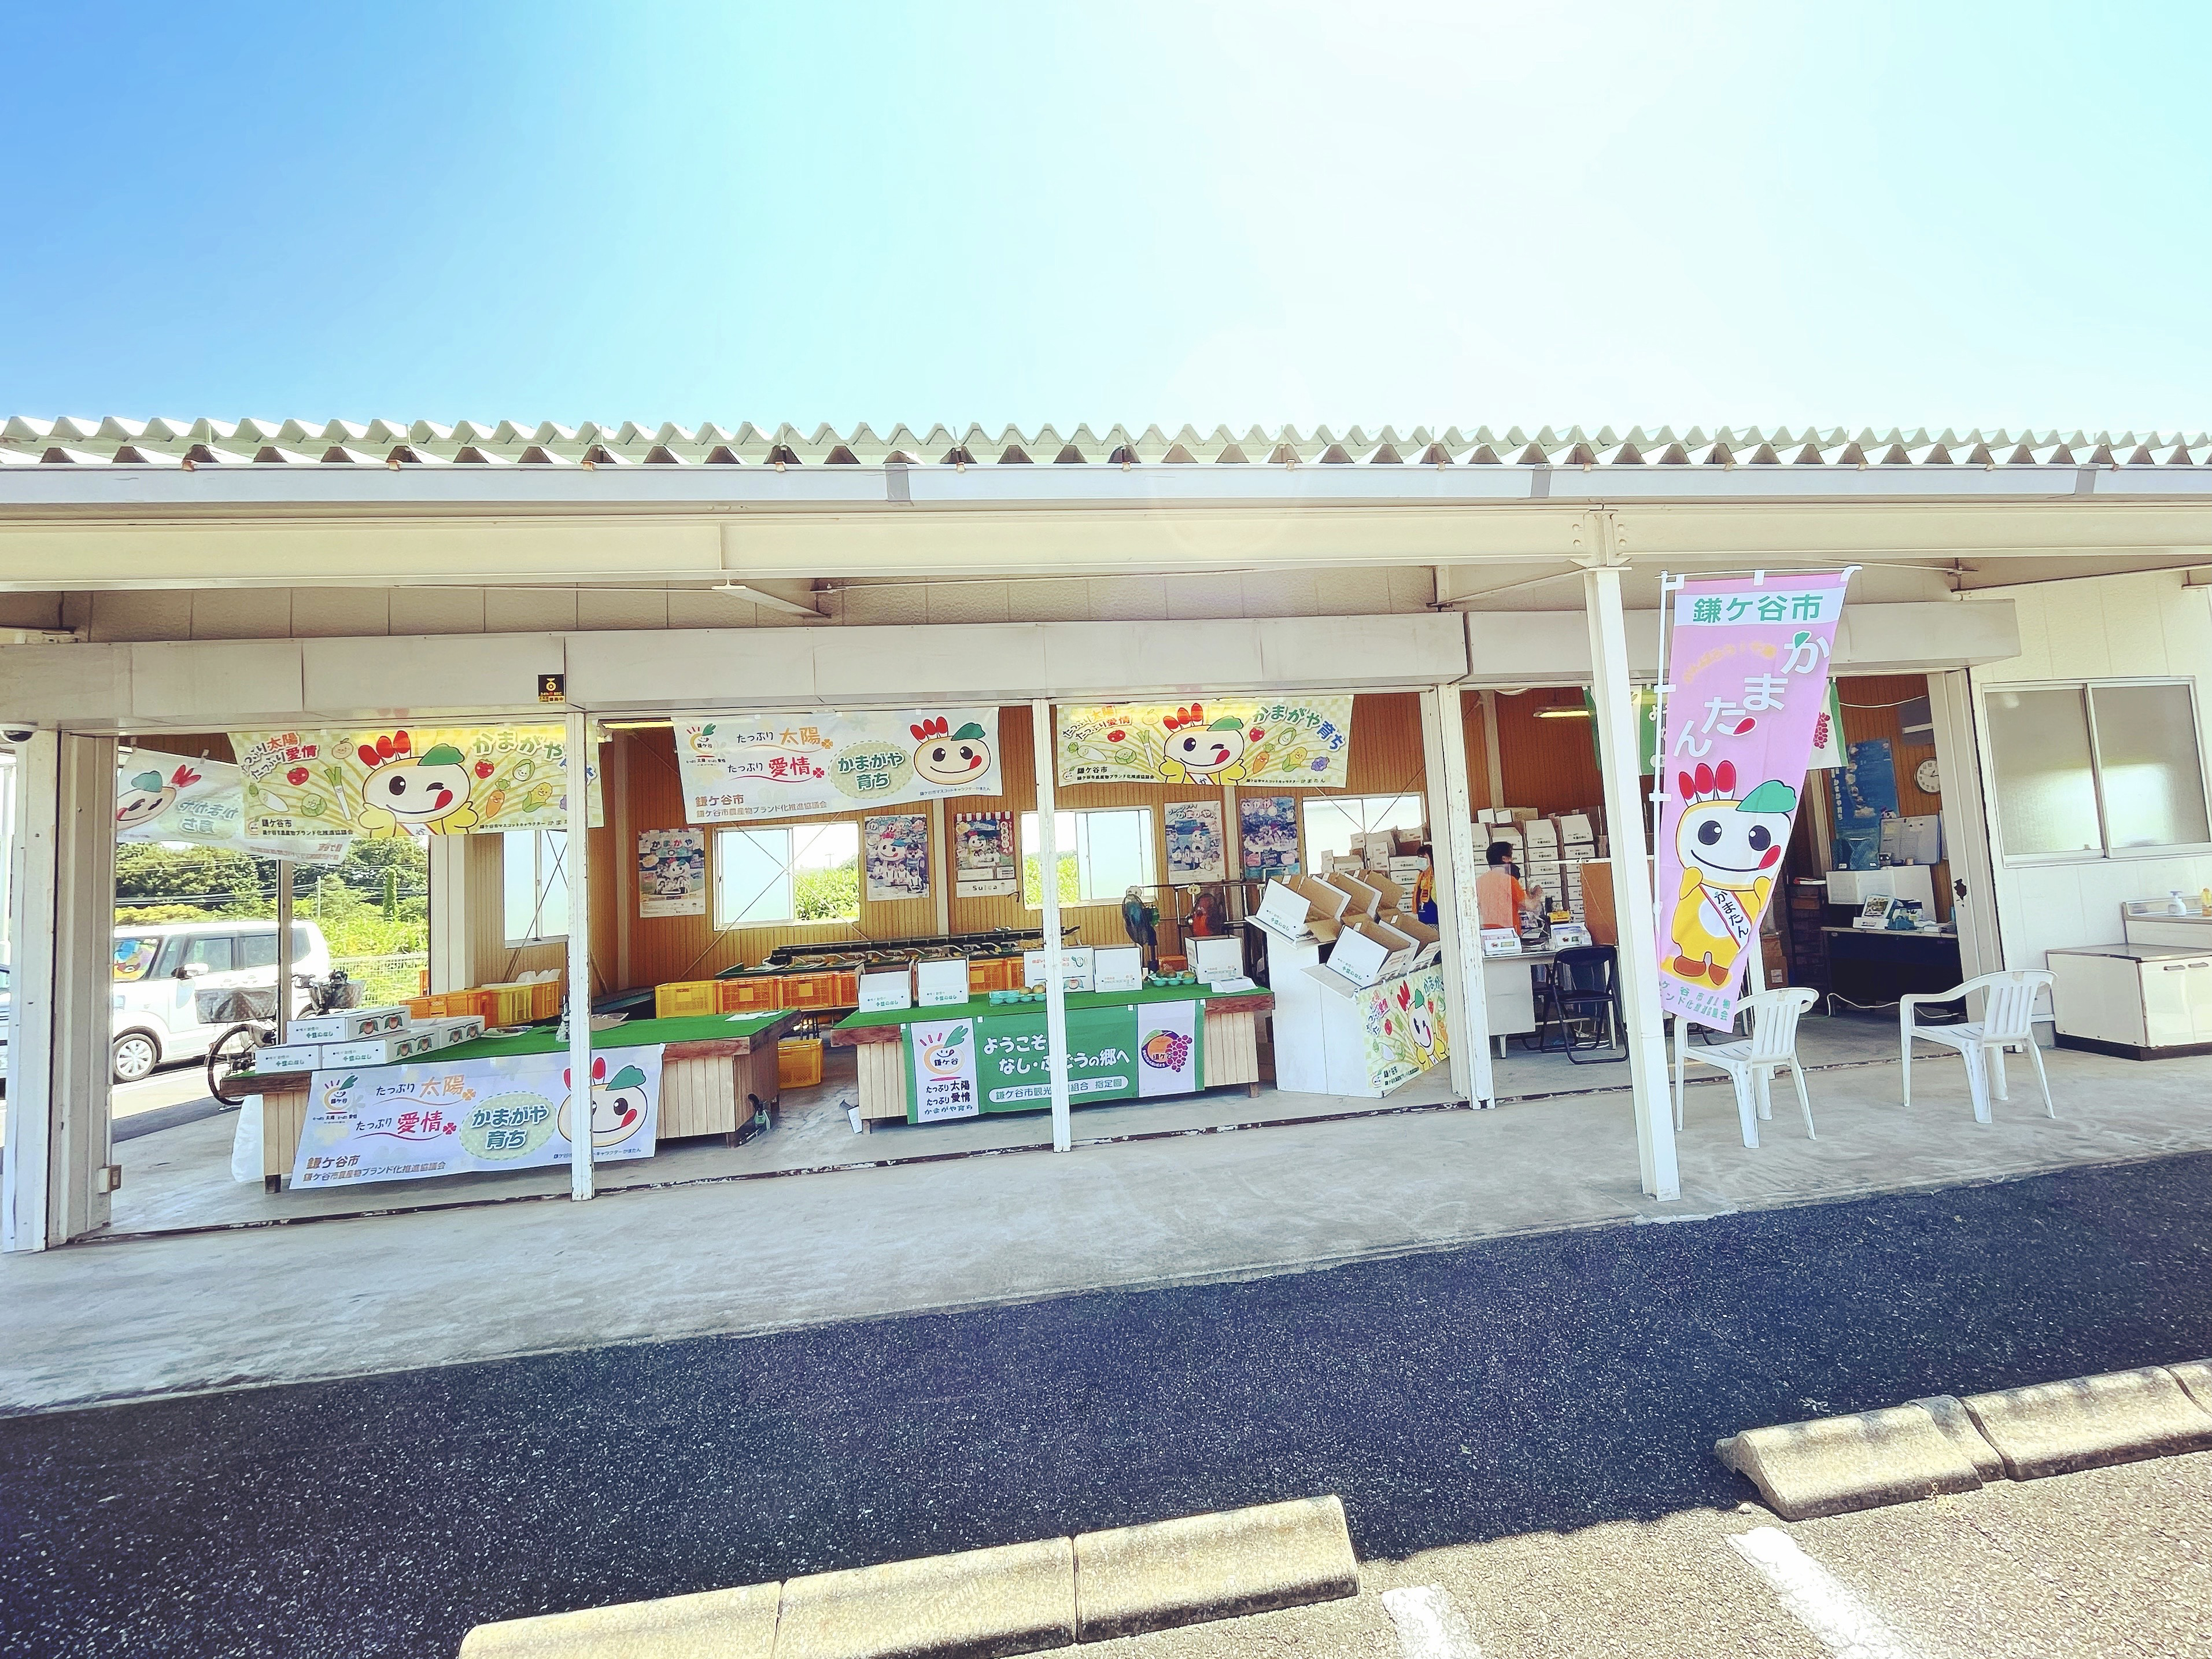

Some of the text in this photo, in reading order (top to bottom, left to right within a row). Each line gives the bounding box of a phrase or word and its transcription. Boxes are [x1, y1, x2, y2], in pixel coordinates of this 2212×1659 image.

[1693, 594, 1823, 623] 鎌ケ谷市
[1674, 630, 1830, 758] かまたん
[838, 751, 904, 773] かまがや
[1077, 766, 1108, 775] 鎌ケ谷市
[856, 773, 891, 791] 育ち
[696, 794, 744, 807] 鎌ケ谷市
[262, 819, 292, 828] 鎌ケ谷市
[1714, 891, 1749, 938] かまたん
[983, 1033, 1047, 1055] ようこそ
[933, 1058, 959, 1067] 鎌ケ谷
[376, 1075, 466, 1098] たっぷり太陽
[926, 1080, 970, 1093] たっぷり太陽
[996, 1082, 1089, 1100] 鎌ケ谷市観光組合
[926, 1092, 970, 1106] たっぷり愛情
[471, 1104, 550, 1128] かまがや
[924, 1104, 973, 1115] かまがや育ち
[355, 1111, 444, 1134] たっぷり愛情
[485, 1128, 526, 1149] 育ち
[306, 1155, 361, 1169] 鎌ケ谷市
